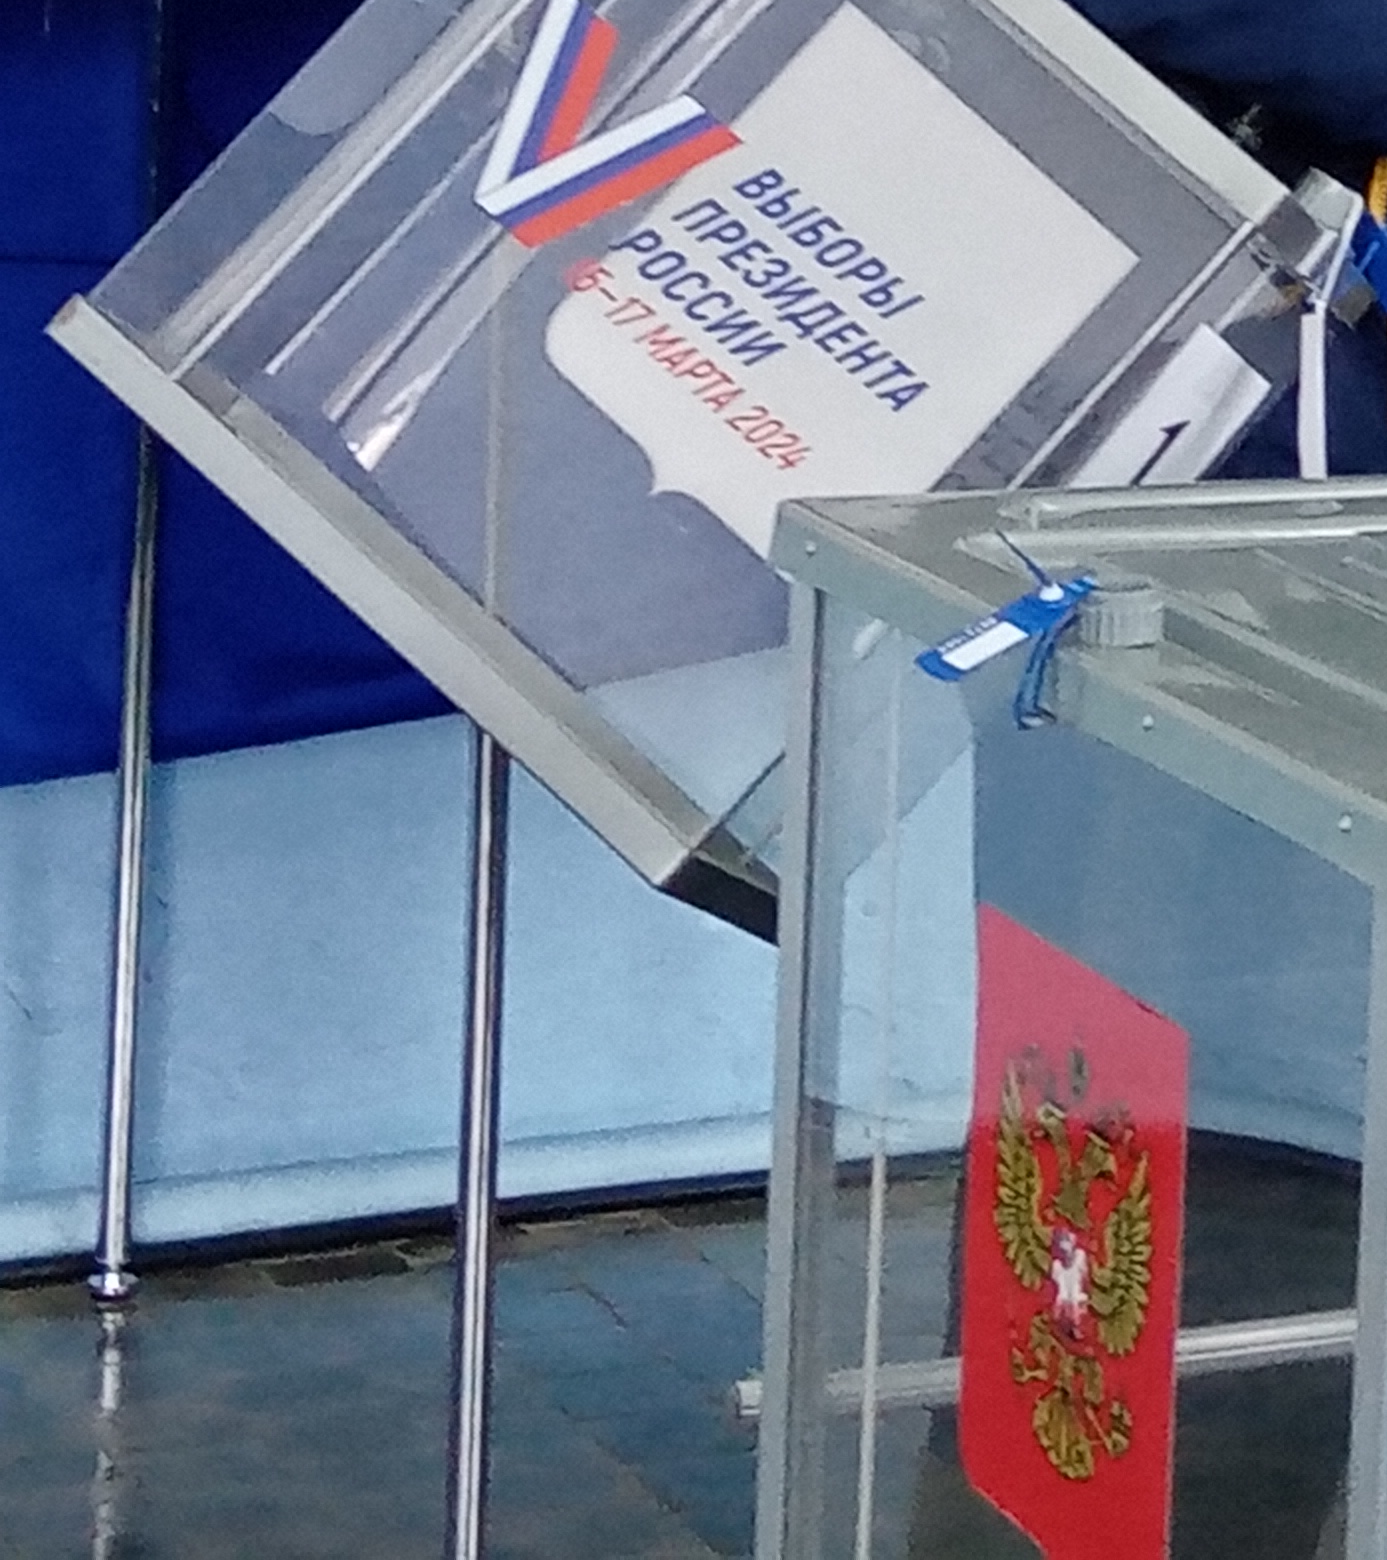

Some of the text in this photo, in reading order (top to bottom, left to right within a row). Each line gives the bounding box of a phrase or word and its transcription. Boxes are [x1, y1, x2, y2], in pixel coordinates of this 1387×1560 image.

[608, 228, 788, 367] РОССИИ
[671, 197, 930, 413] ПРЕЗИДЕНТА
[732, 168, 925, 320] ВЫБОРЫ
[566, 258, 811, 470] 5-17 МАРТА 2024
